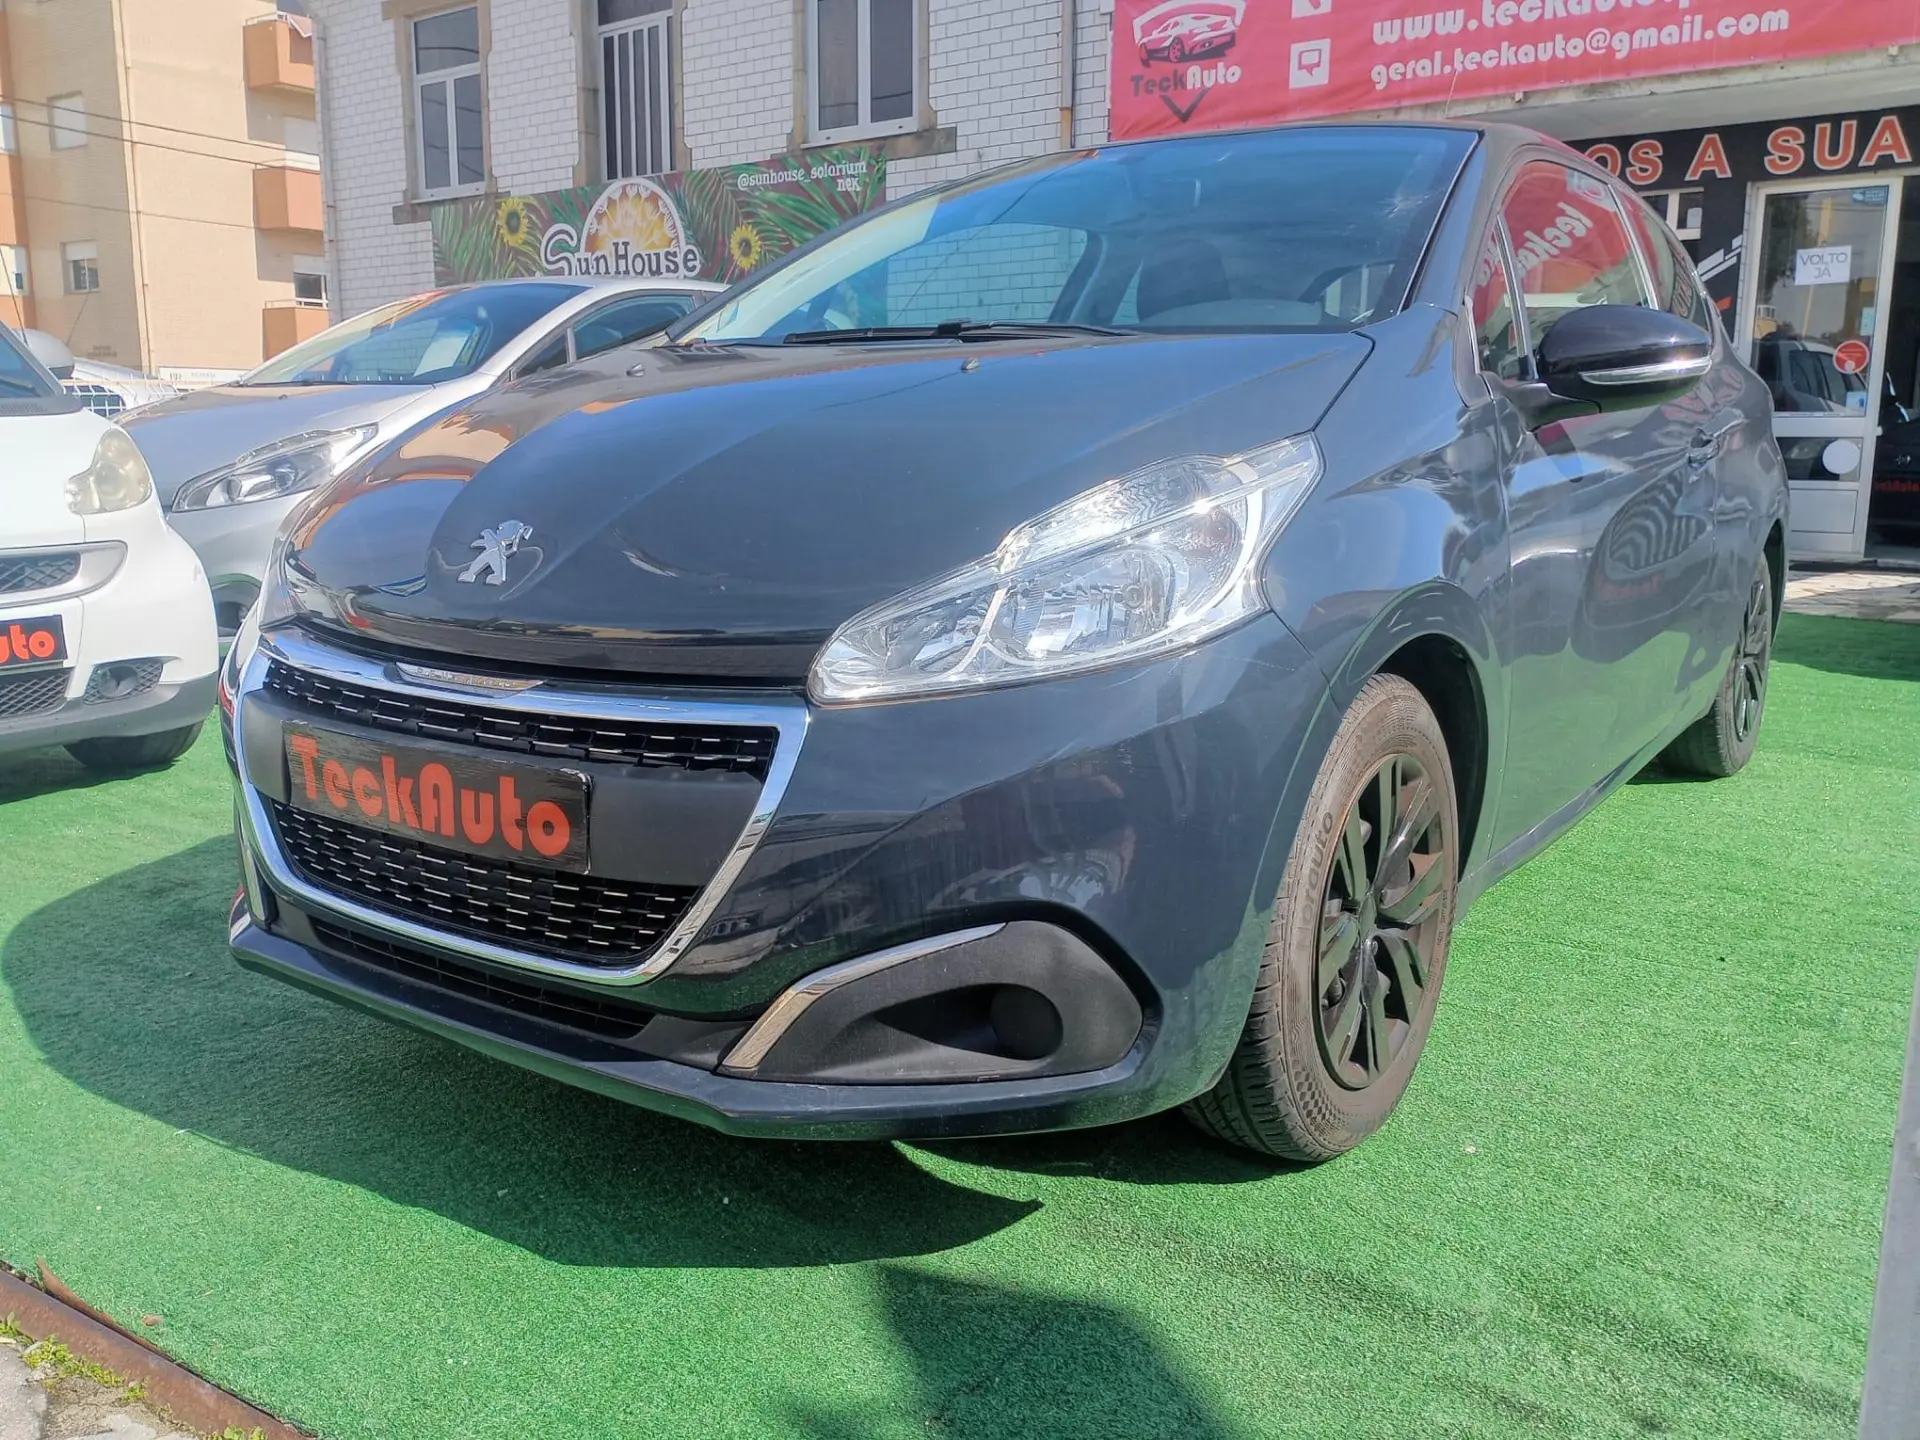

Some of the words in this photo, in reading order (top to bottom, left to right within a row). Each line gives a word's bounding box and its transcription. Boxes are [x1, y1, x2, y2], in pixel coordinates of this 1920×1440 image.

[1373, 0, 1691, 45] www.tecka
[1371, 9, 1789, 90] geral.teckauto@gmail.com
[1131, 62, 1242, 97] TeckAuto
[1684, 133, 1732, 181] A
[1764, 115, 1912, 175] SUA
[737, 161, 867, 190] @sunhouse_solarium
[541, 223, 700, 277] SunHouse
[1800, 252, 1848, 266] VOLTO
[291, 734, 571, 857] TeckAuto
